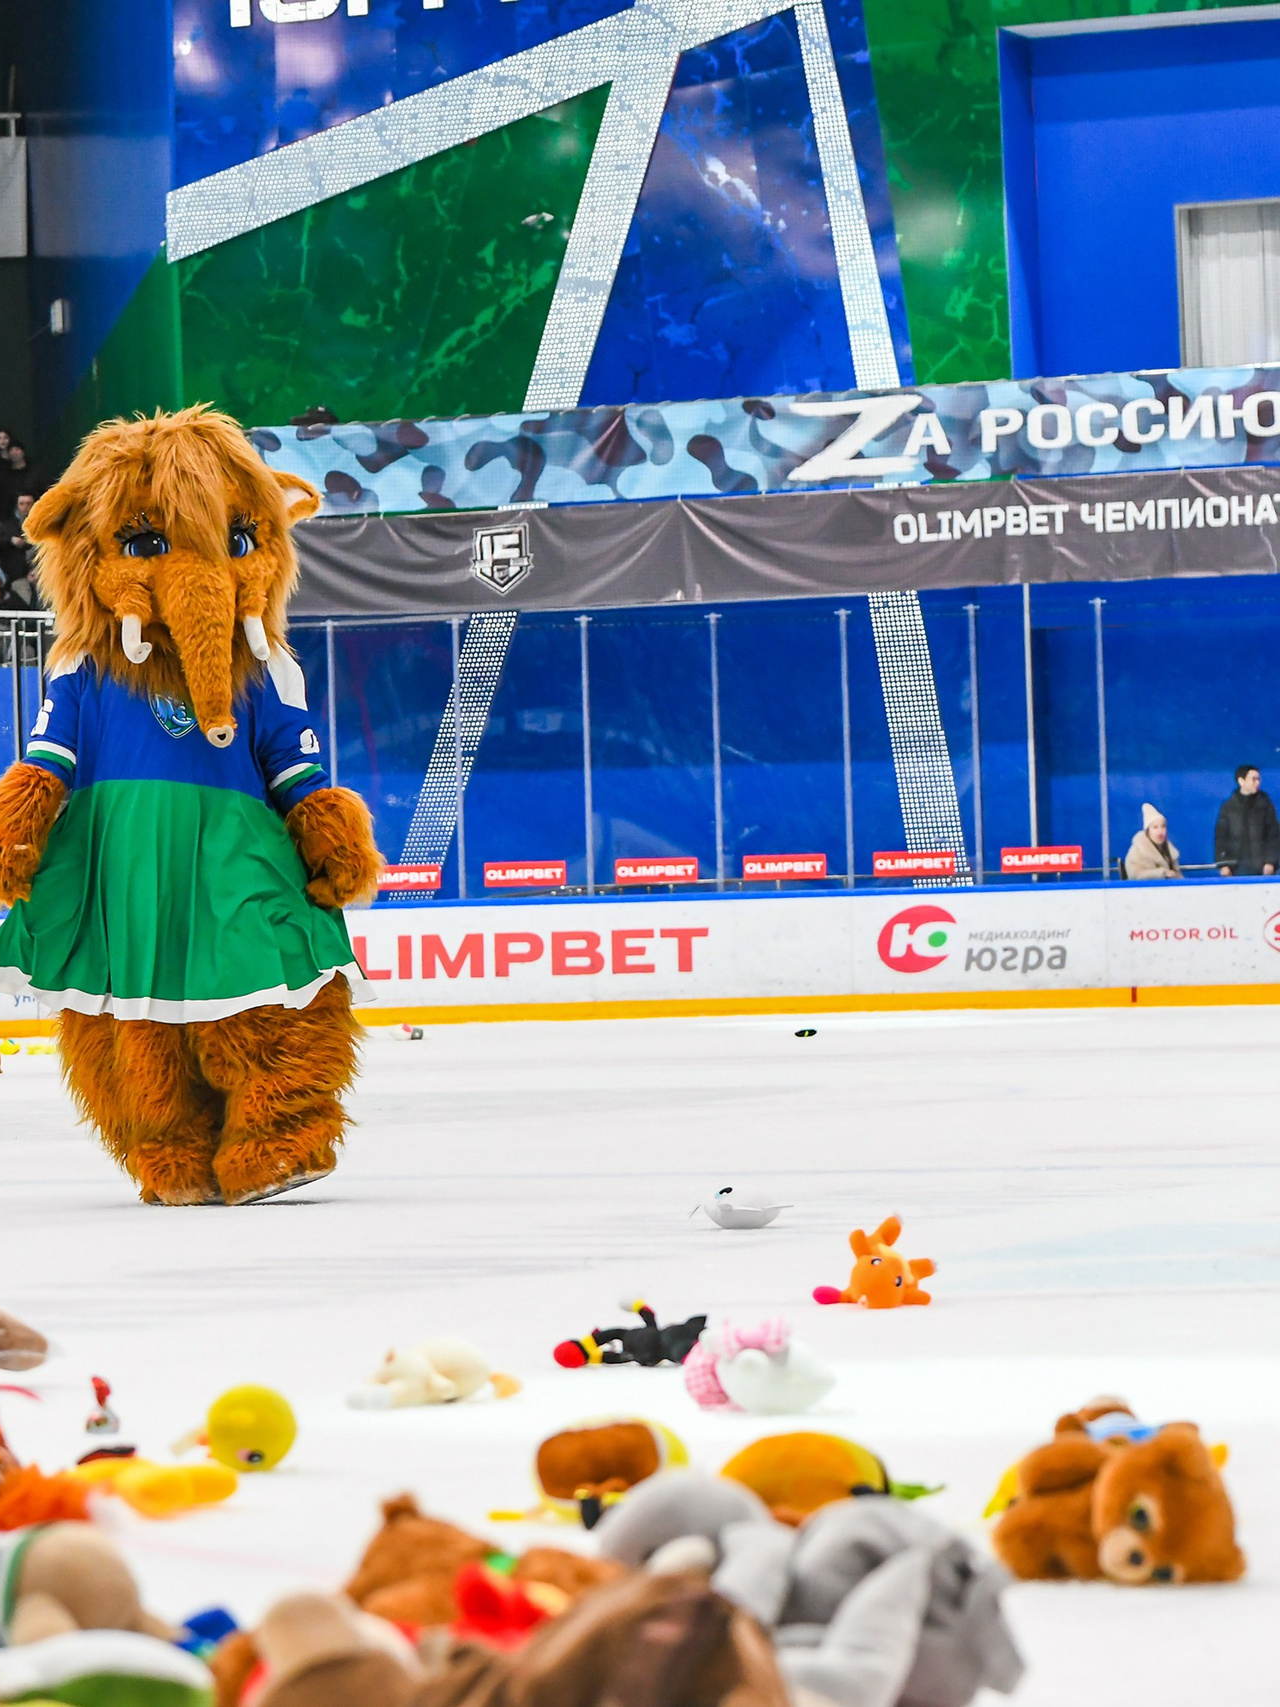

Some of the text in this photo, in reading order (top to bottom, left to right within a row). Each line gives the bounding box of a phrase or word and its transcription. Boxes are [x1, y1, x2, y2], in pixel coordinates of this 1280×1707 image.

[980, 391, 1280, 454] РОССИЮ
[892, 494, 1280, 545] OLIMPBET ЧЕМПИОНА
[744, 860, 824, 873] OLIMPBET
[875, 857, 952, 871] OLIMPBET
[1001, 853, 1079, 867] OLIMPBET
[485, 867, 563, 881] OLIMPBET
[616, 864, 695, 878] OLIMPBET
[968, 929, 1072, 943] МЕДИАХОЛДИНГ
[1130, 926, 1239, 941] MOTOR OIL
[352, 927, 710, 981] LIMPBET
